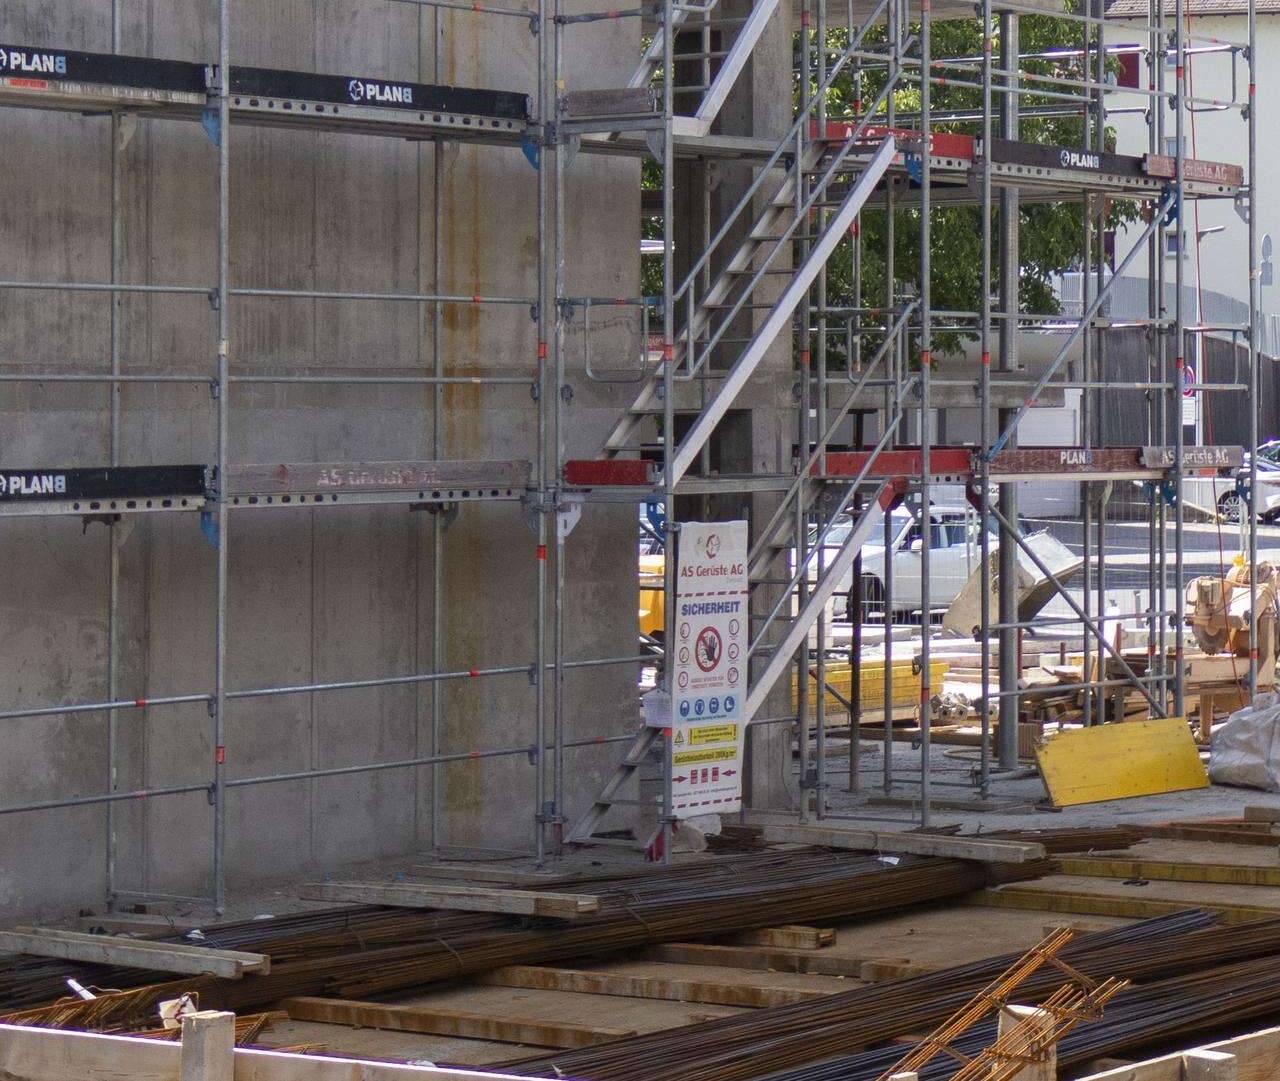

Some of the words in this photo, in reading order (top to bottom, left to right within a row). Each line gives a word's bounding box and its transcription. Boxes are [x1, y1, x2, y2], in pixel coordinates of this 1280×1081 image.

[10, 51, 66, 74] PLANB
[366, 84, 413, 103] PLANB
[10, 475, 66, 494] PLANB
[681, 566, 694, 578] AS
[696, 564, 728, 577] Gerüste
[730, 563, 744, 575] AG
[681, 601, 741, 616] SICHERHEIT
